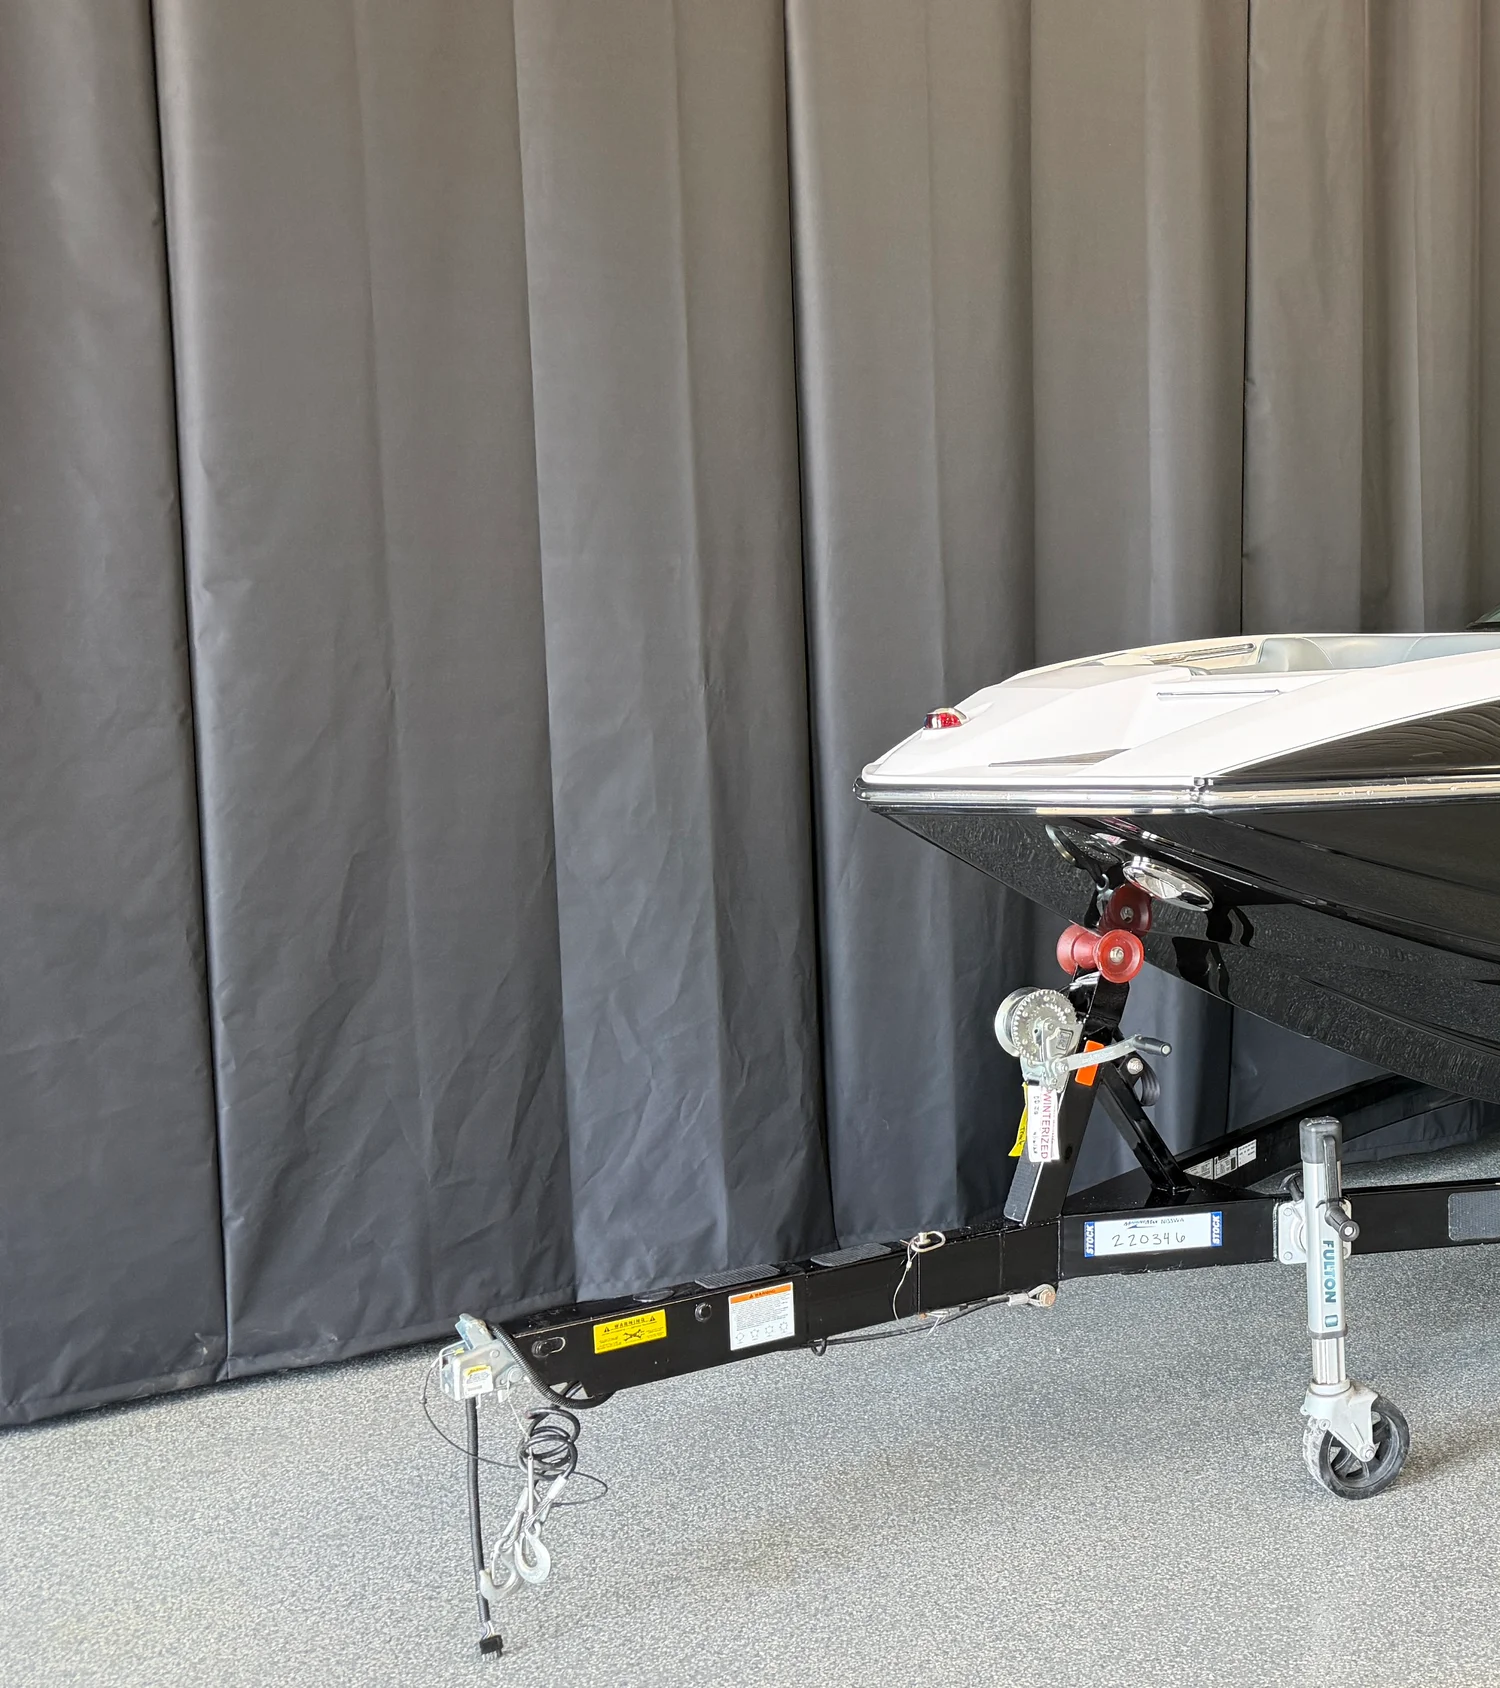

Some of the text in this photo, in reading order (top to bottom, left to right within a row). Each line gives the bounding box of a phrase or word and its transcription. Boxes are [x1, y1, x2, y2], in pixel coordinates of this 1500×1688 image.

[1040, 1090, 1053, 1160] WINTERIZED
[1085, 1224, 1095, 1255] STOCK
[1111, 1232, 1186, 1247] 220346
[1212, 1214, 1221, 1244] STOCK
[1322, 1240, 1337, 1303] FULTON
[614, 1317, 646, 1329] WARNING
